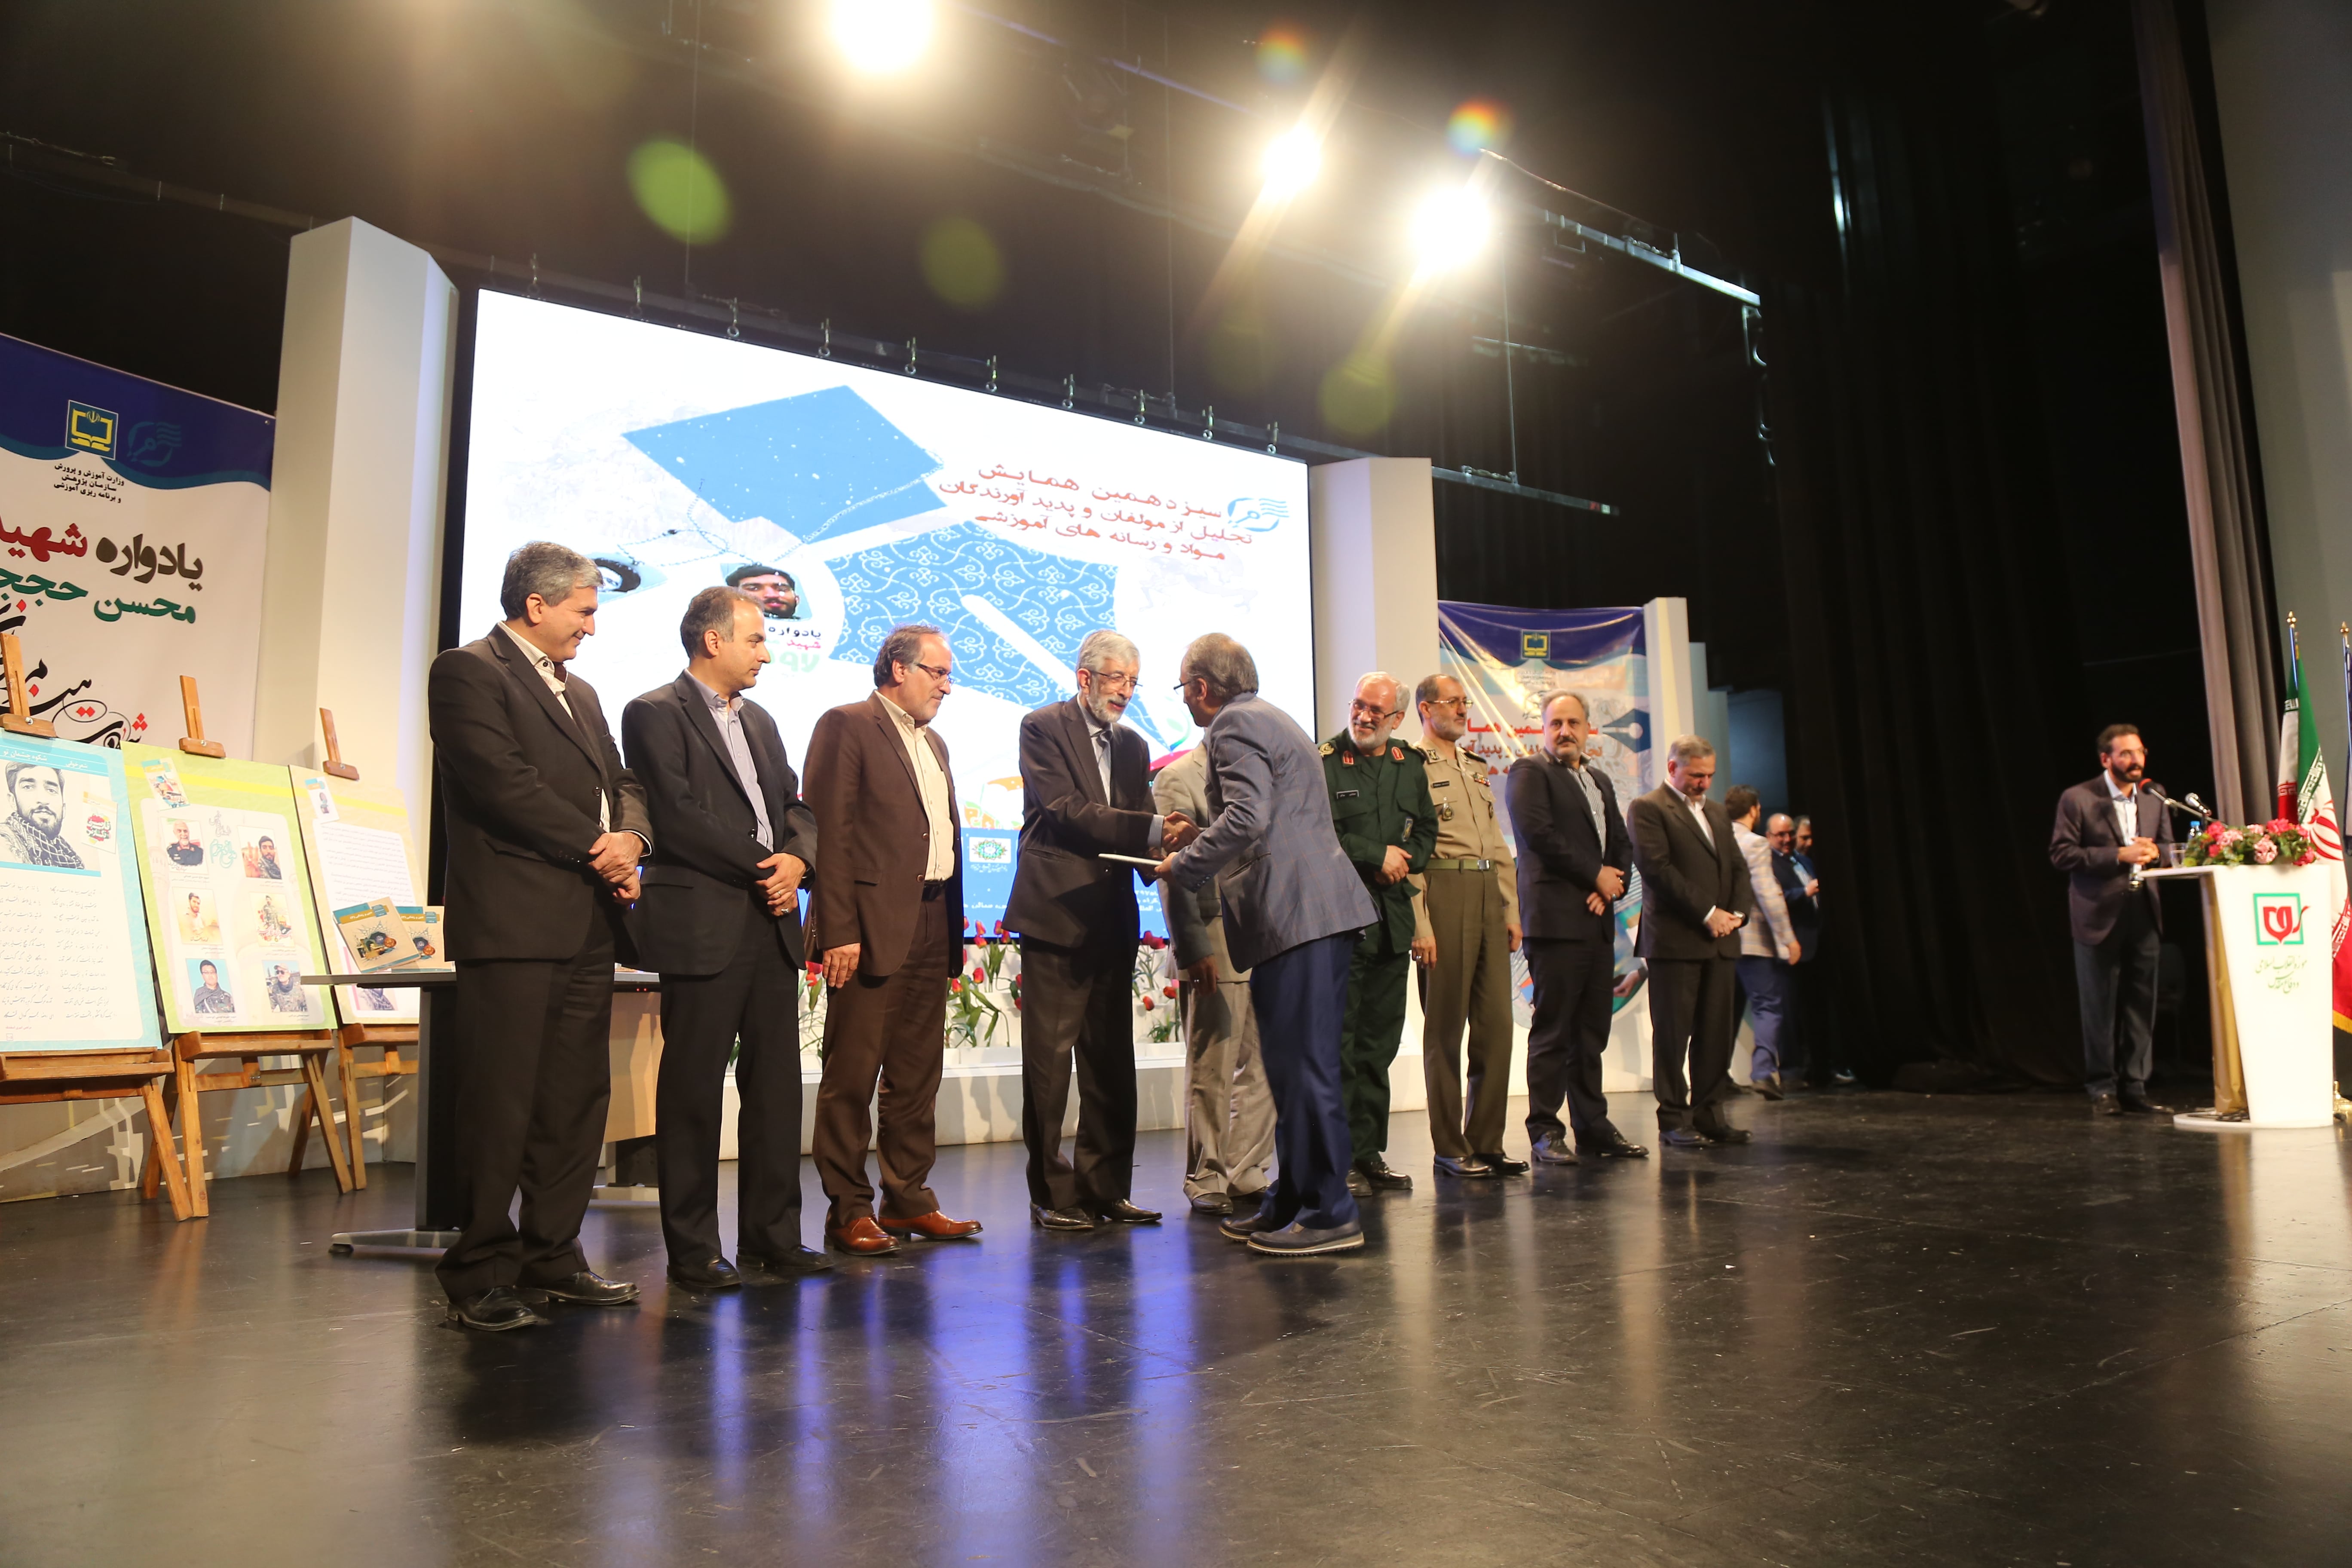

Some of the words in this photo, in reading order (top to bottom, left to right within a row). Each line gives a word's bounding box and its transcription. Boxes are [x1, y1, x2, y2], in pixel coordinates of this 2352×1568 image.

[54, 463, 76, 474] پرورش
[83, 471, 105, 479] آموزش
[61, 475, 87, 486] پژوهش
[107, 475, 125, 486] وزارت
[979, 464, 1079, 491] همایش
[54, 482, 78, 492] آموزشی
[89, 481, 116, 491] سازمان
[80, 489, 96, 497] ریزی
[98, 492, 116, 502] برنامه
[1032, 497, 1074, 518] پدید
[1081, 507, 1092, 519] و
[1100, 510, 1165, 531] مولفان
[1056, 524, 1101, 538] های
[1169, 521, 1183, 534] از
[1109, 532, 1157, 551] رسانه
[1190, 526, 1252, 545] تجلیل
[1161, 542, 1173, 554] و
[1180, 544, 1225, 560] مواد
[95, 533, 203, 591] یادواره
[0, 567, 89, 606] حجج
[94, 597, 196, 624] محسن
[768, 626, 821, 640] یادواره
[786, 639, 821, 650] شهید
